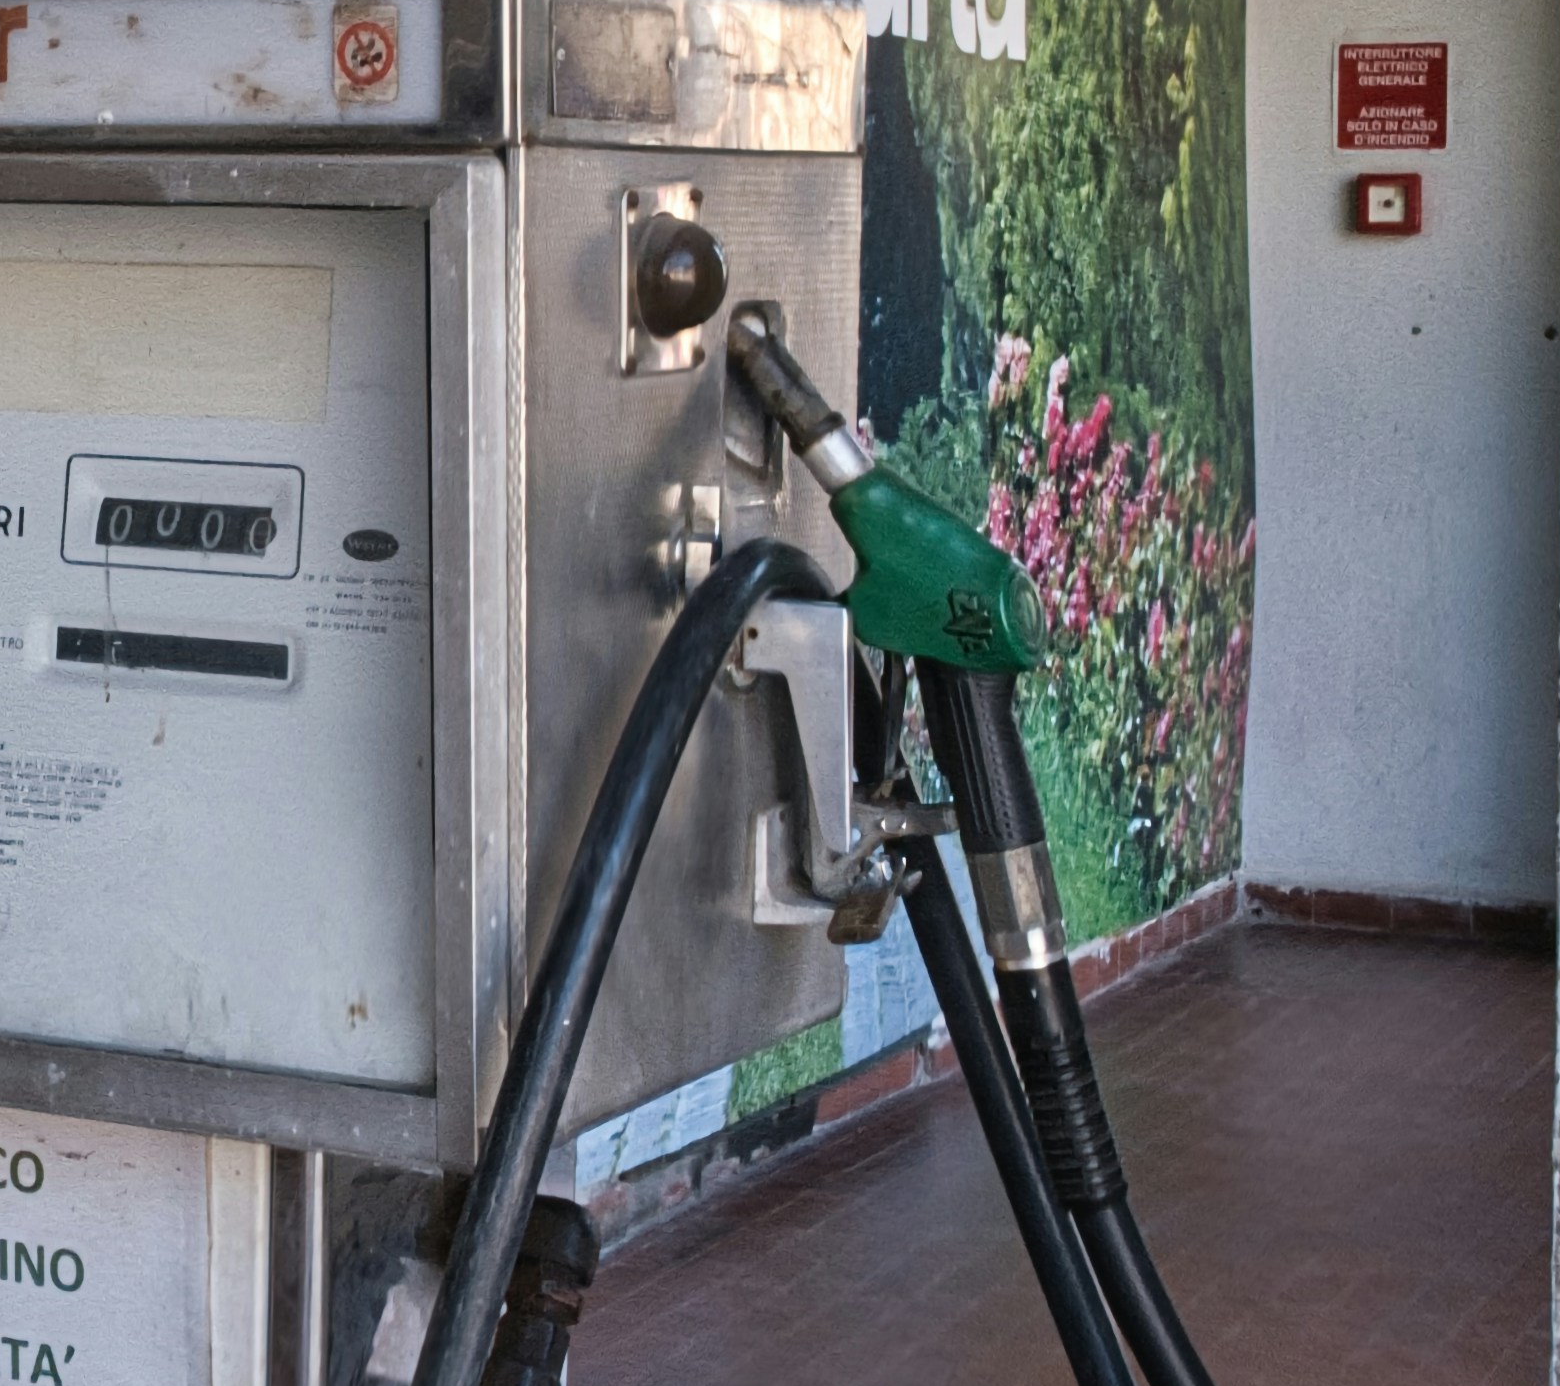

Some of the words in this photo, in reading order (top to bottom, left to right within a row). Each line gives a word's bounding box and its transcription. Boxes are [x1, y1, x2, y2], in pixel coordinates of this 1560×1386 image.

[1344, 47, 1443, 60] INTERRUTTORE
[1357, 60, 1429, 73] ELETTRICO
[1358, 74, 1427, 86] GENERALE
[1359, 106, 1425, 118] AZIONARE
[1346, 120, 1381, 132] SOLO
[1385, 120, 1398, 132] IN
[1401, 120, 1438, 132] CASO
[1354, 133, 1430, 146] D'INCENDIO
